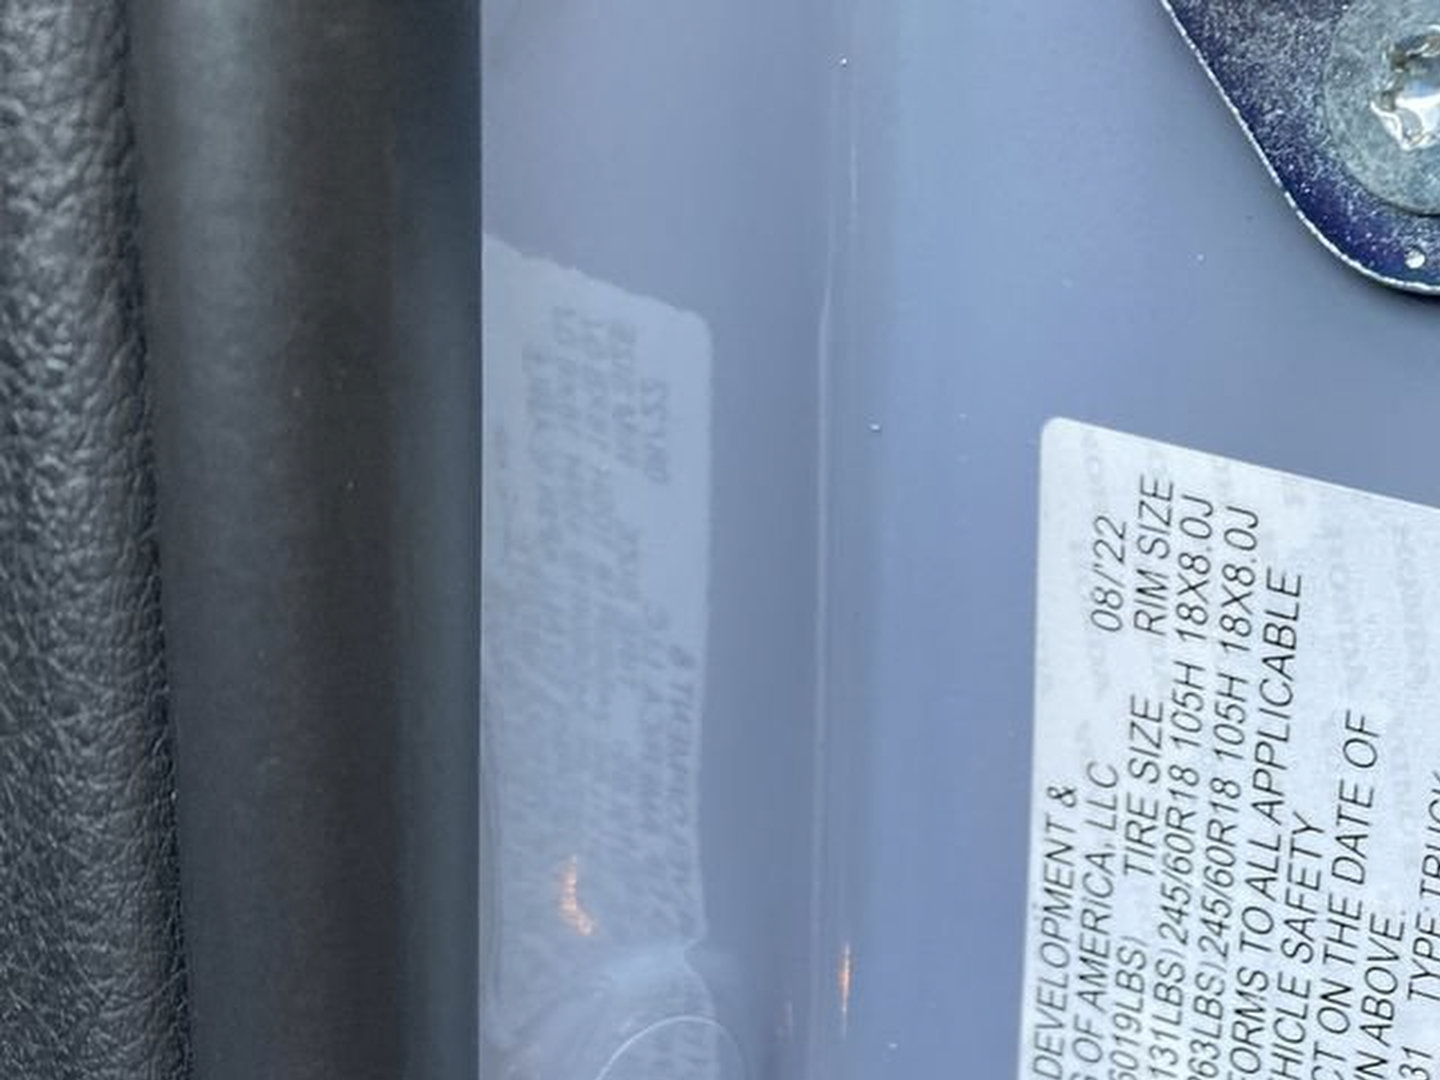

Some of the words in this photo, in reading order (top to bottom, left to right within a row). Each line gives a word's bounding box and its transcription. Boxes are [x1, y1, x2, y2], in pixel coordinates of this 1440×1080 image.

[1135, 474, 1174, 560] SIZE
[1088, 514, 1127, 633] 08/'22
[1132, 567, 1168, 636] RIM
[1174, 493, 1214, 641] 18X8.0J
[1217, 504, 1259, 653] 18X8.0J
[1126, 694, 1164, 784] SIZE
[1168, 659, 1205, 748] 105H
[1211, 671, 1249, 760] 105H
[1250, 566, 1302, 826] APPLICABLE
[1341, 709, 1379, 769] OF
[1046, 785, 1076, 808] &
[1084, 760, 1119, 831] LLC
[1121, 791, 1159, 876] TIRE
[1330, 778, 1374, 885] DATE
[1243, 833, 1282, 902] ALL
[1279, 810, 1325, 964] SAFETY
[1031, 812, 1076, 1080] DEVELOPMENT
[1074, 838, 1115, 1013] AMERICA,
[1238, 905, 1275, 952] TO
[1321, 892, 1363, 965] THE
[1315, 977, 1354, 1035] ON
[1358, 902, 1405, 1048] ABOVE.
[1070, 1013, 1104, 1064] OF
